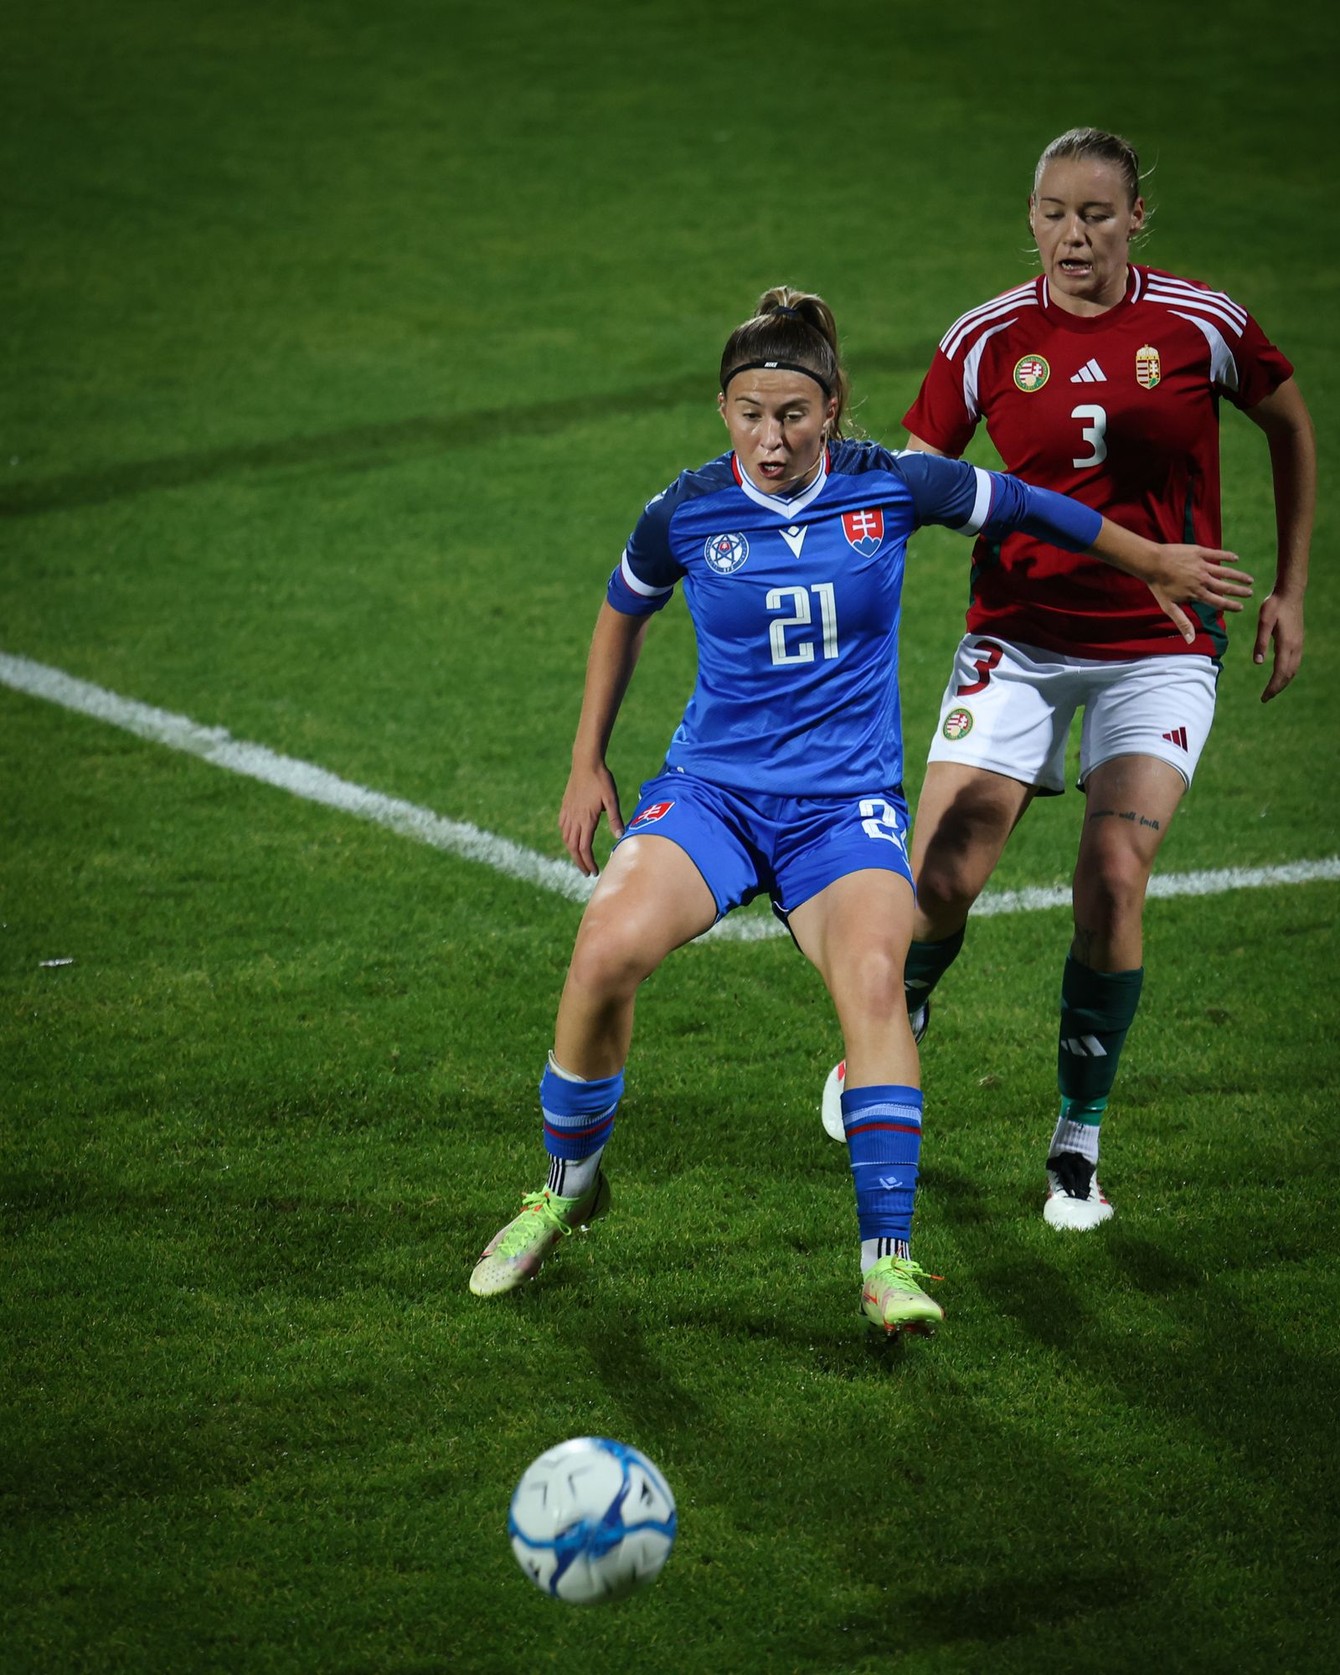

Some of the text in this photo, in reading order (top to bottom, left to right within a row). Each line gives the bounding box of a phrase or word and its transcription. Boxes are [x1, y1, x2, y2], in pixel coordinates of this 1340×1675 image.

[1070, 404, 1108, 469] 3
[766, 582, 839, 666] 21
[956, 640, 1004, 697] 3
[858, 798, 907, 851] 2
